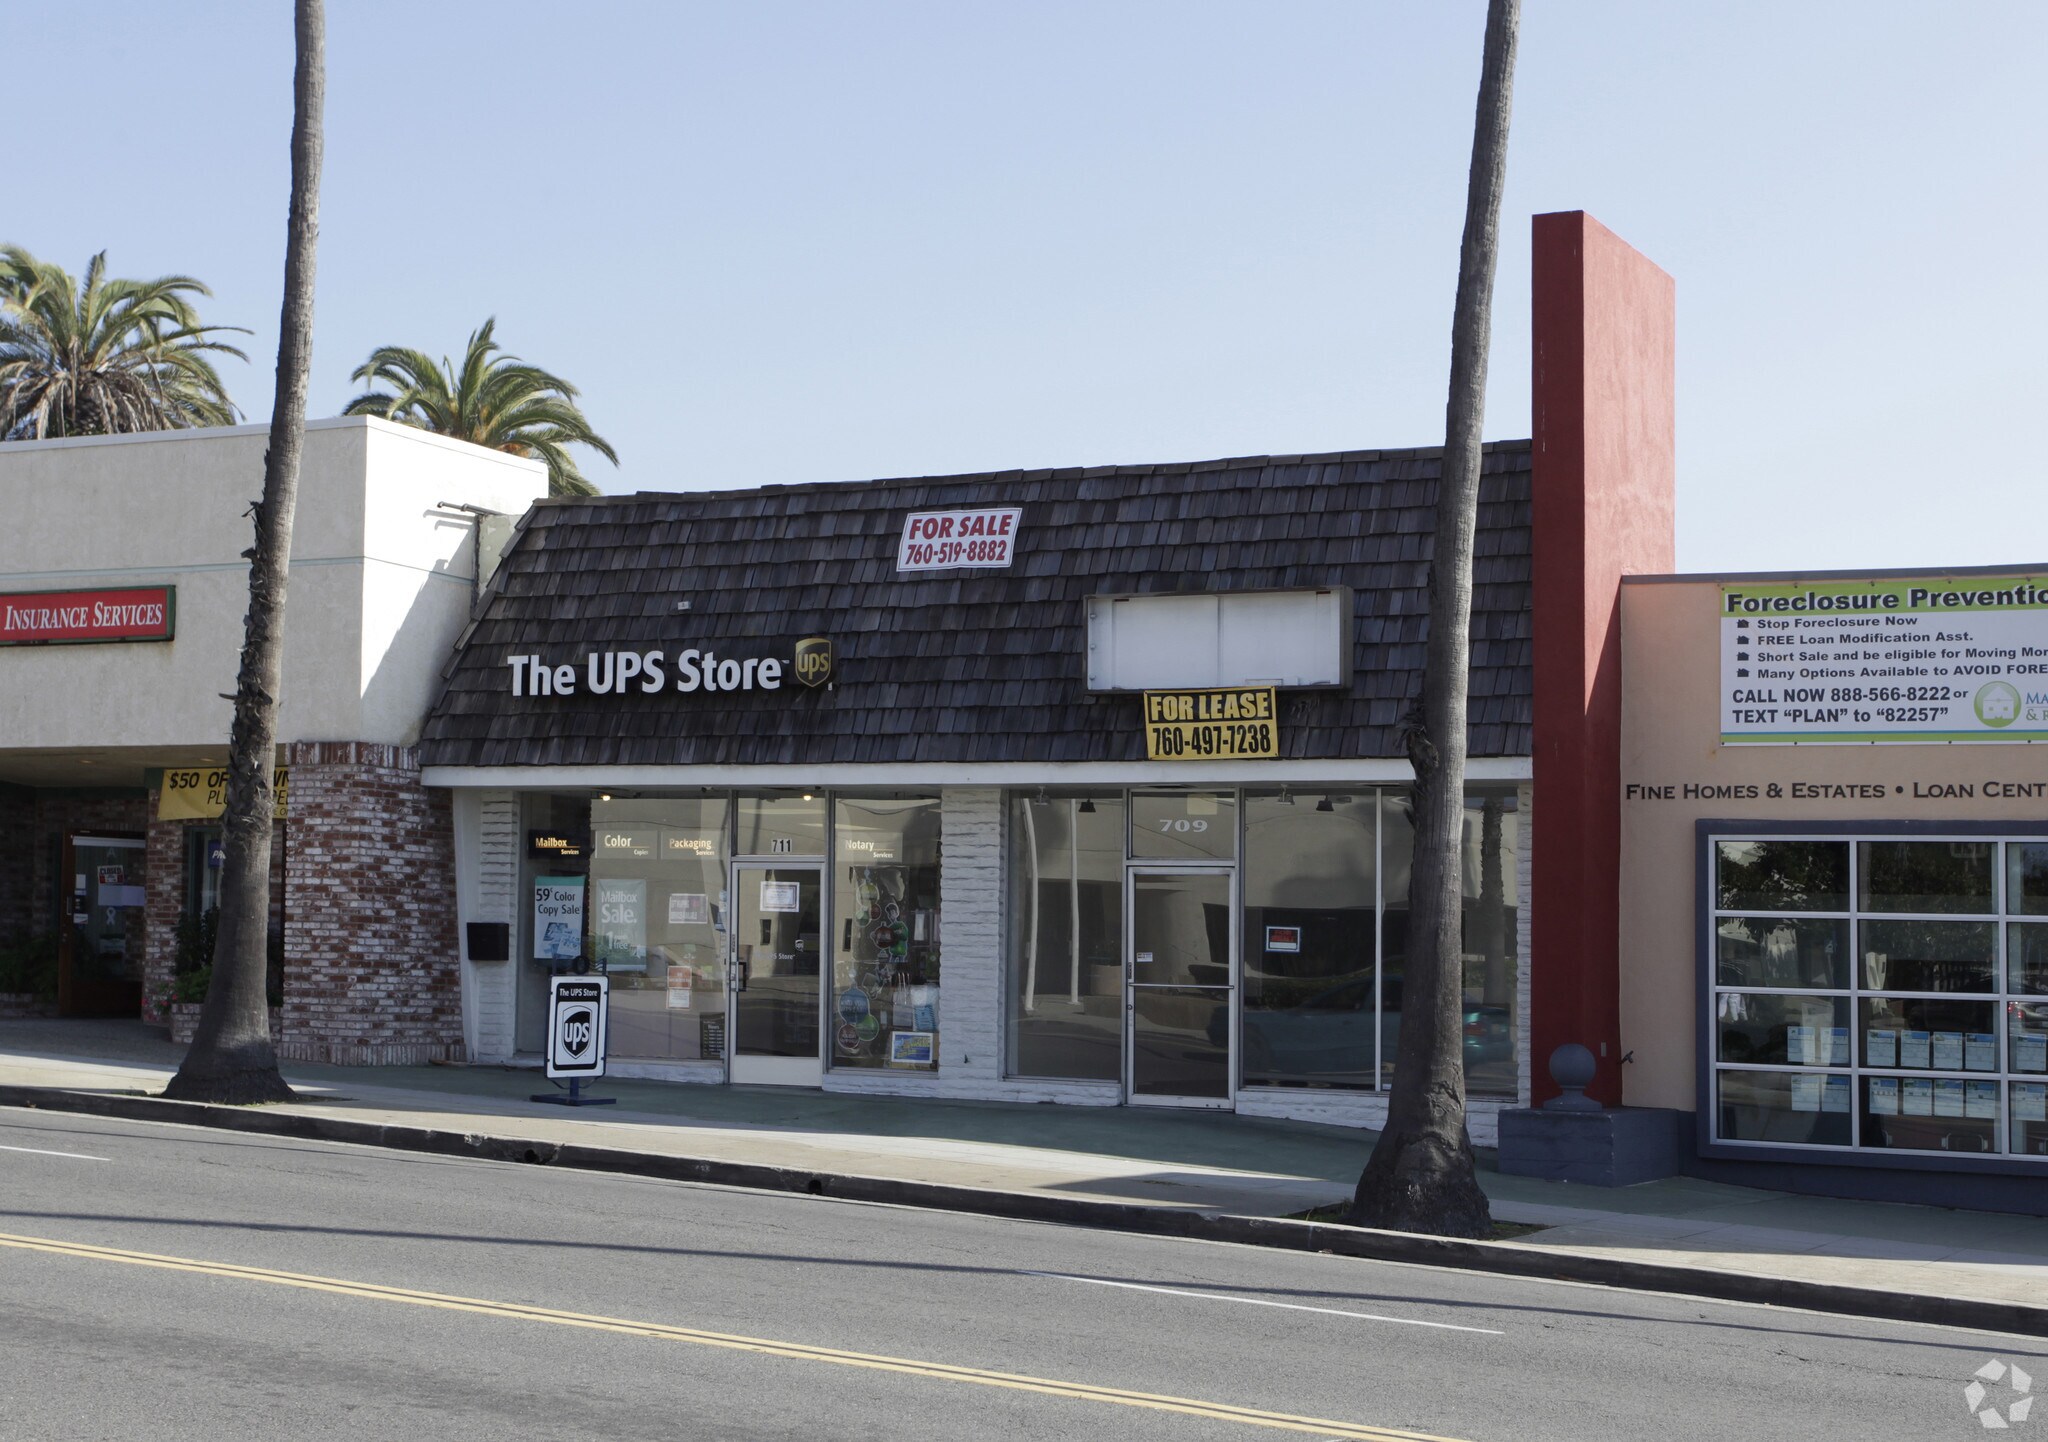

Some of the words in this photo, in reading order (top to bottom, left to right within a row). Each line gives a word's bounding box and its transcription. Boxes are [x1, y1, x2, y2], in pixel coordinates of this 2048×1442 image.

[908, 517, 955, 540] FOR
[958, 514, 1013, 538] SALE
[905, 540, 1007, 565] 760-519-8882
[1726, 591, 1900, 613] Foreclosure
[4, 605, 88, 630] INSURANCE
[93, 602, 163, 627] SERVICES
[1757, 618, 1790, 631] Stop
[1795, 617, 1880, 629] Foreclosure
[1885, 615, 1918, 626] Now
[1757, 635, 1795, 646] FREE
[1800, 634, 1835, 645] Loan
[1839, 632, 1931, 644] Modification
[1935, 631, 1974, 642] Asst.
[1757, 652, 1795, 663] Short
[1799, 651, 1829, 662] Sale
[1833, 650, 1859, 661] and
[1863, 650, 1880, 661] be
[1884, 648, 1937, 662] eligible
[1941, 648, 1961, 659] for
[1965, 647, 2016, 660] Moving
[507, 654, 576, 697] The
[588, 650, 665, 695] UPS
[677, 649, 782, 693] Store
[798, 653, 829, 680] ups
[1757, 669, 1796, 681] Many
[1800, 668, 1856, 680] Options
[1860, 666, 1929, 678] Available
[1933, 665, 1949, 677] to
[1953, 664, 2002, 676] AVOID
[2006, 664, 2048, 675] FORE
[1732, 688, 1778, 703] CALL
[1783, 687, 1826, 703] NOW
[1830, 686, 1951, 703] 888-566-8222
[1953, 689, 1969, 700] or
[1149, 695, 1194, 721] FOR
[1198, 692, 1270, 720] LEASE
[2025, 708, 2040, 721] &
[1732, 708, 1779, 724] TEXT
[1853, 708, 1871, 723] to
[1152, 723, 1271, 756] 760-497-7238
[169, 771, 200, 790] $50
[1625, 783, 1676, 800] FINE
[1683, 783, 1759, 800] HOMES
[1766, 782, 1783, 799] &
[1791, 782, 1886, 799] ESTATES
[1913, 781, 1974, 798] LOAN
[1982, 781, 2047, 798] CENT
[1159, 819, 1208, 832] 709
[535, 837, 568, 848] Mailbox
[603, 834, 632, 848] Color
[669, 838, 712, 850] Packaging
[772, 839, 792, 853] 711
[845, 839, 875, 852] Notary
[873, 851, 894, 859] Services
[554, 890, 576, 902] Color
[600, 889, 638, 903] Mailbox
[537, 903, 559, 917] Copy
[601, 903, 638, 924] Sale.
[559, 988, 570, 997] The
[570, 988, 583, 997] UPS
[583, 988, 598, 998] Store
[563, 1022, 590, 1051] ups
